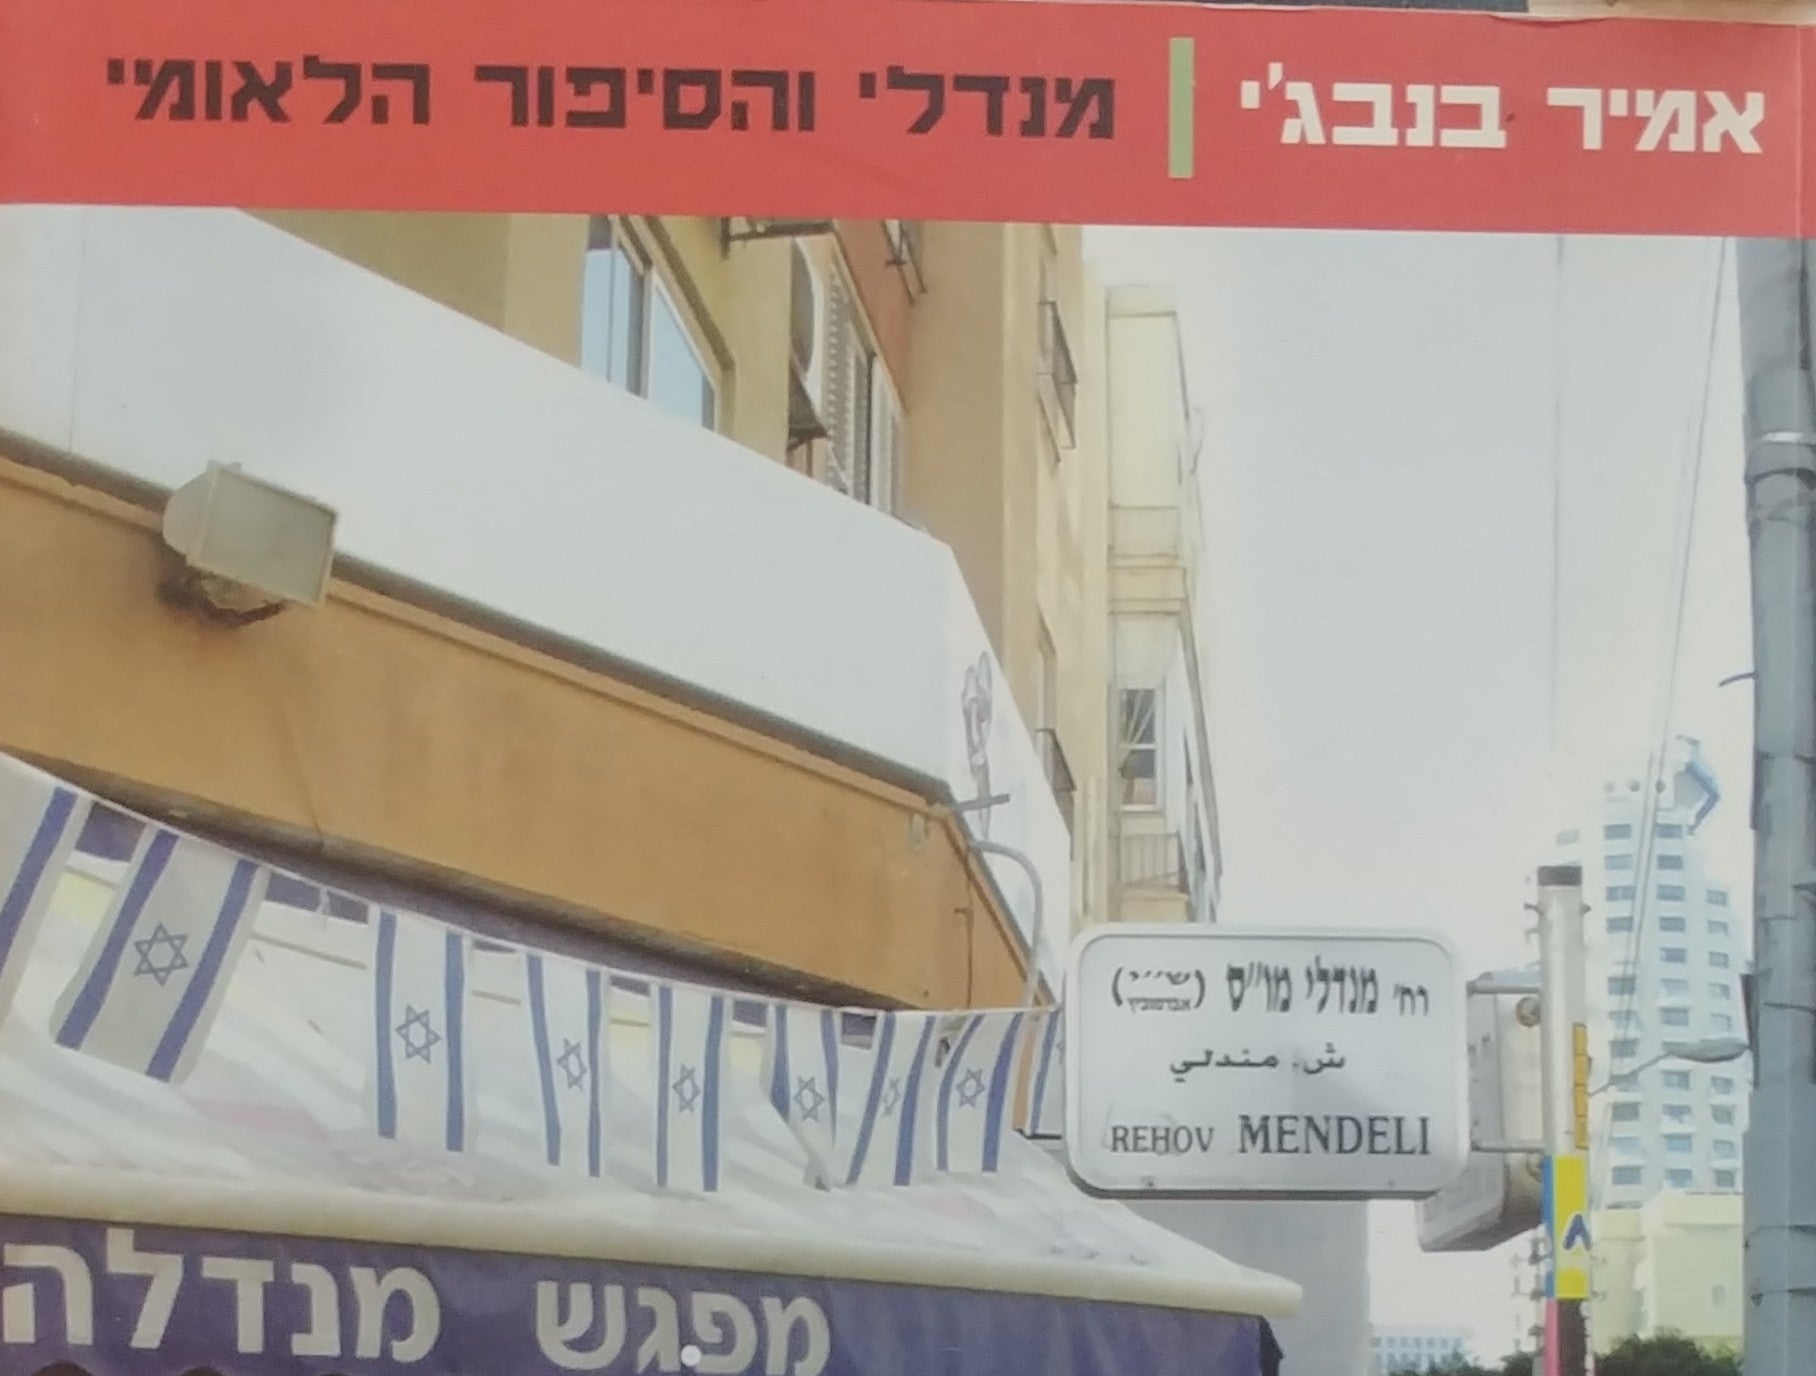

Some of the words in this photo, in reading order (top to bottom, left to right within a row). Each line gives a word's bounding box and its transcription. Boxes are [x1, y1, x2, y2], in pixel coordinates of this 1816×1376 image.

[106, 54, 431, 126] הלאומי
[473, 64, 816, 133] והסיפור
[858, 64, 1116, 140] מנדלי
[1239, 61, 1508, 150] בנבג'י
[1545, 84, 1766, 156] אמיר
[1304, 954, 1380, 1014] מנדלי
[1169, 1048, 1281, 1084] مندلي
[1110, 1124, 1216, 1156] REHOV
[1237, 1113, 1432, 1157] MENDELI
[0, 1226, 443, 1364] מנדלה
